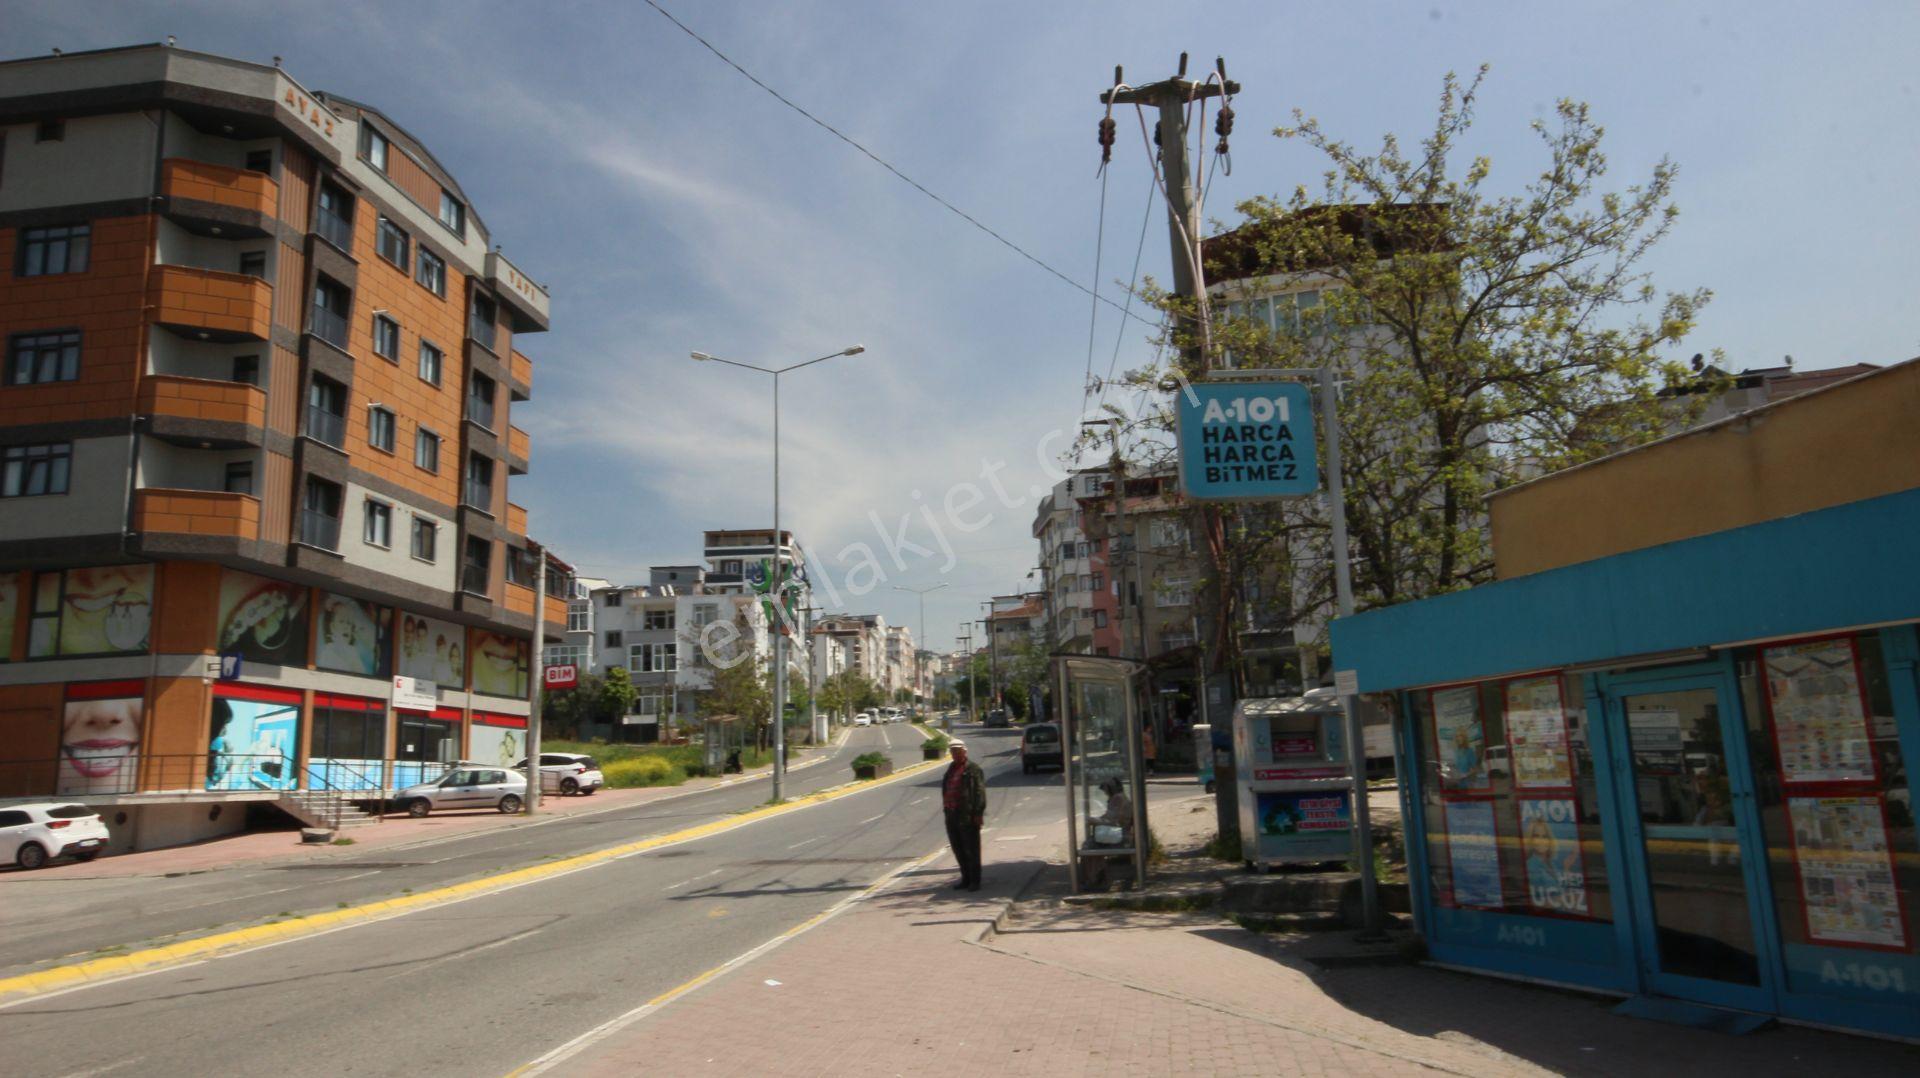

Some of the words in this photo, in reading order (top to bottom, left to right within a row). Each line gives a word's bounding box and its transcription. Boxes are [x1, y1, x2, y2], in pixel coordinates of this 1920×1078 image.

[285, 87, 334, 137] AYAZ
[1203, 424, 1294, 443] HARCA
[1204, 444, 1295, 464] HARCA
